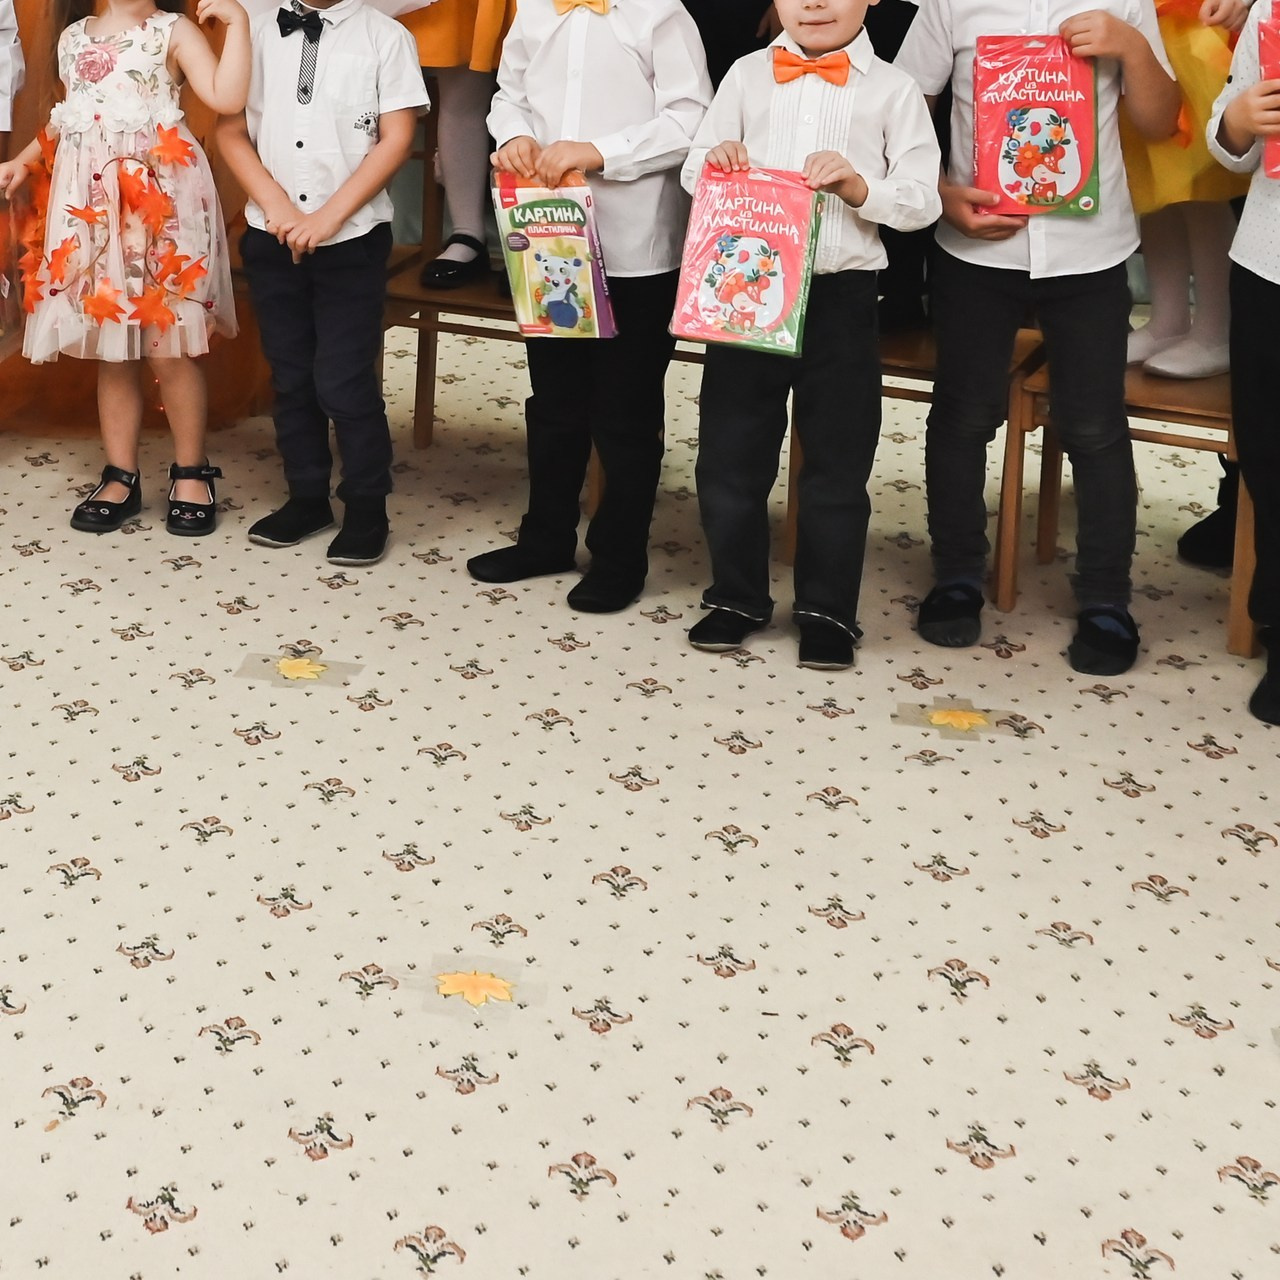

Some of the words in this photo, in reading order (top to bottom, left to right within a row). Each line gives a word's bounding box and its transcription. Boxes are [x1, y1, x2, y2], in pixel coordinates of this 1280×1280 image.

[998, 68, 1069, 85] КАРТИНА
[989, 89, 1085, 104] ПЛАСТИЛИНА
[716, 196, 785, 216] КАРТИНА
[513, 207, 584, 223] КАРТИНА
[527, 225, 577, 234] ПЛАСТИЛИНА
[702, 215, 799, 236] ПЛАСТИЛИНА
